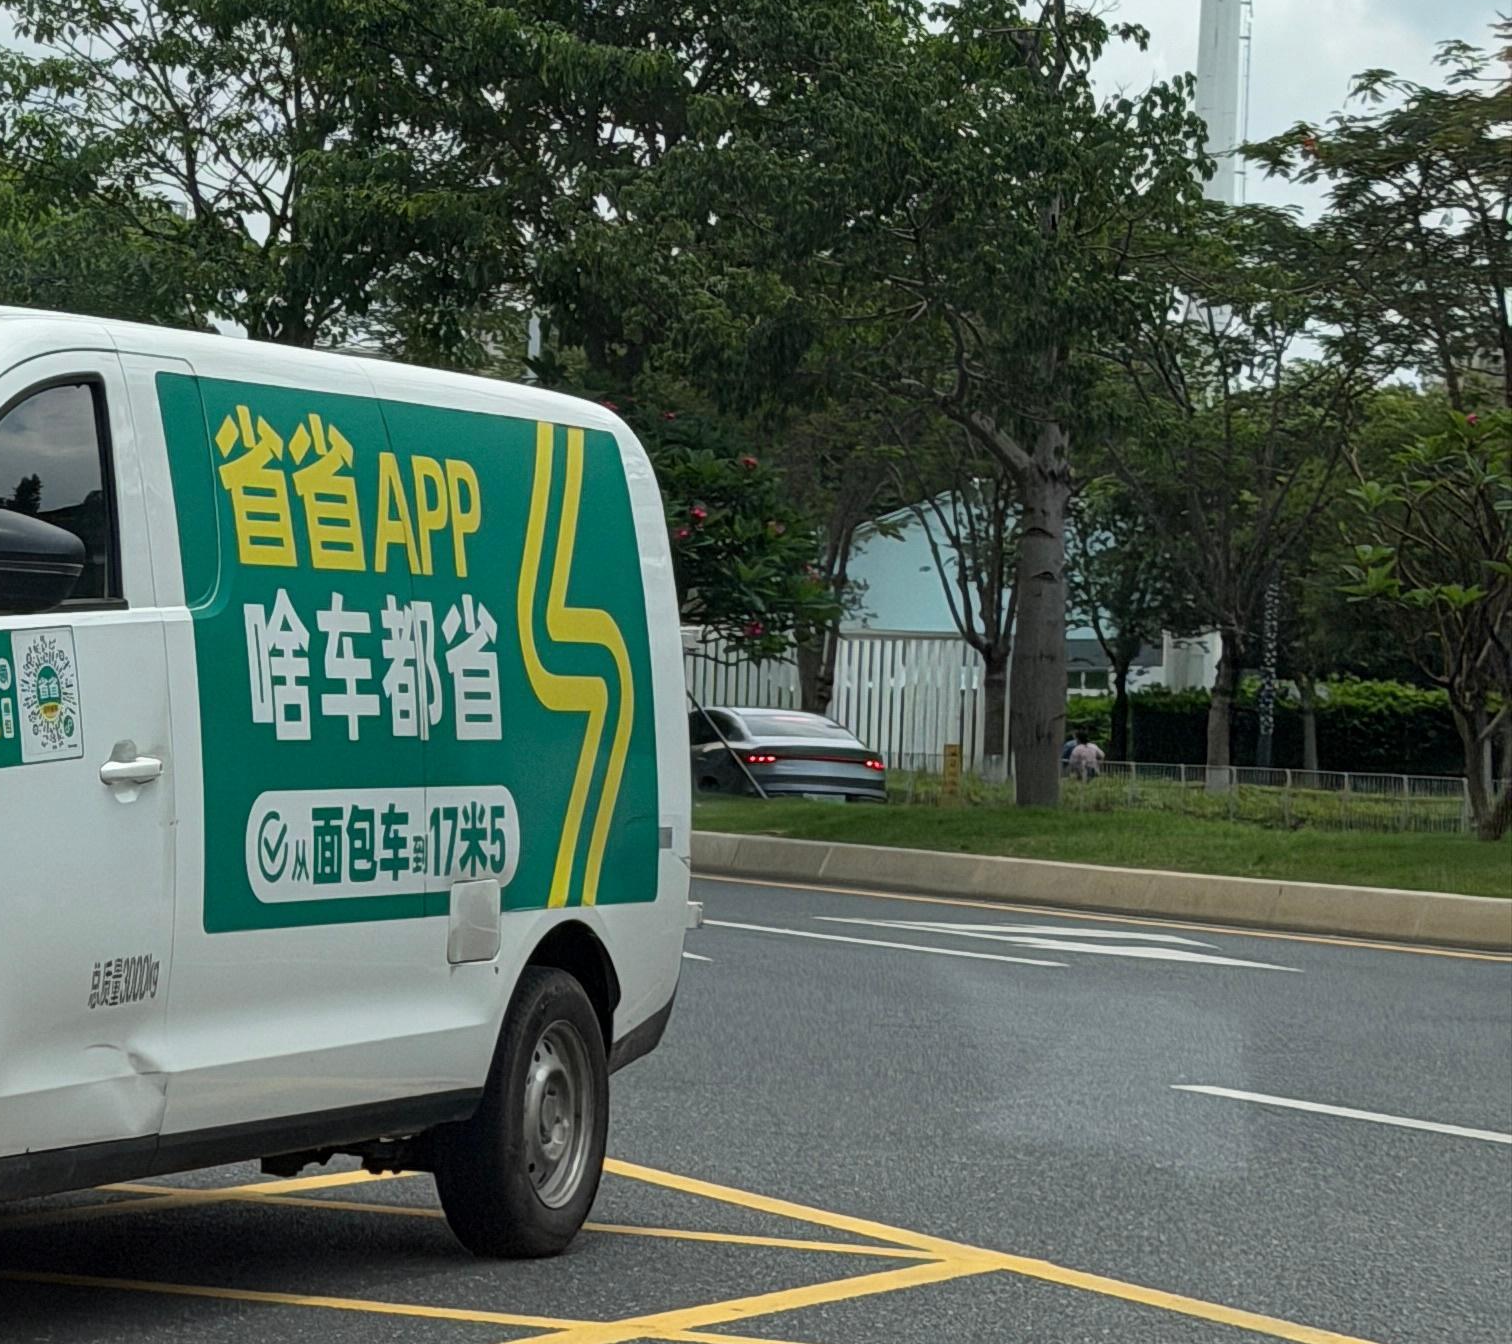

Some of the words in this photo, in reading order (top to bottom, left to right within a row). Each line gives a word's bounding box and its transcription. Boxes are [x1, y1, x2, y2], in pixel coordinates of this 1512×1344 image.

[215, 404, 482, 578] 省省APP
[243, 587, 503, 741] 啥车都省
[291, 800, 507, 886] 从面包车到17米5
